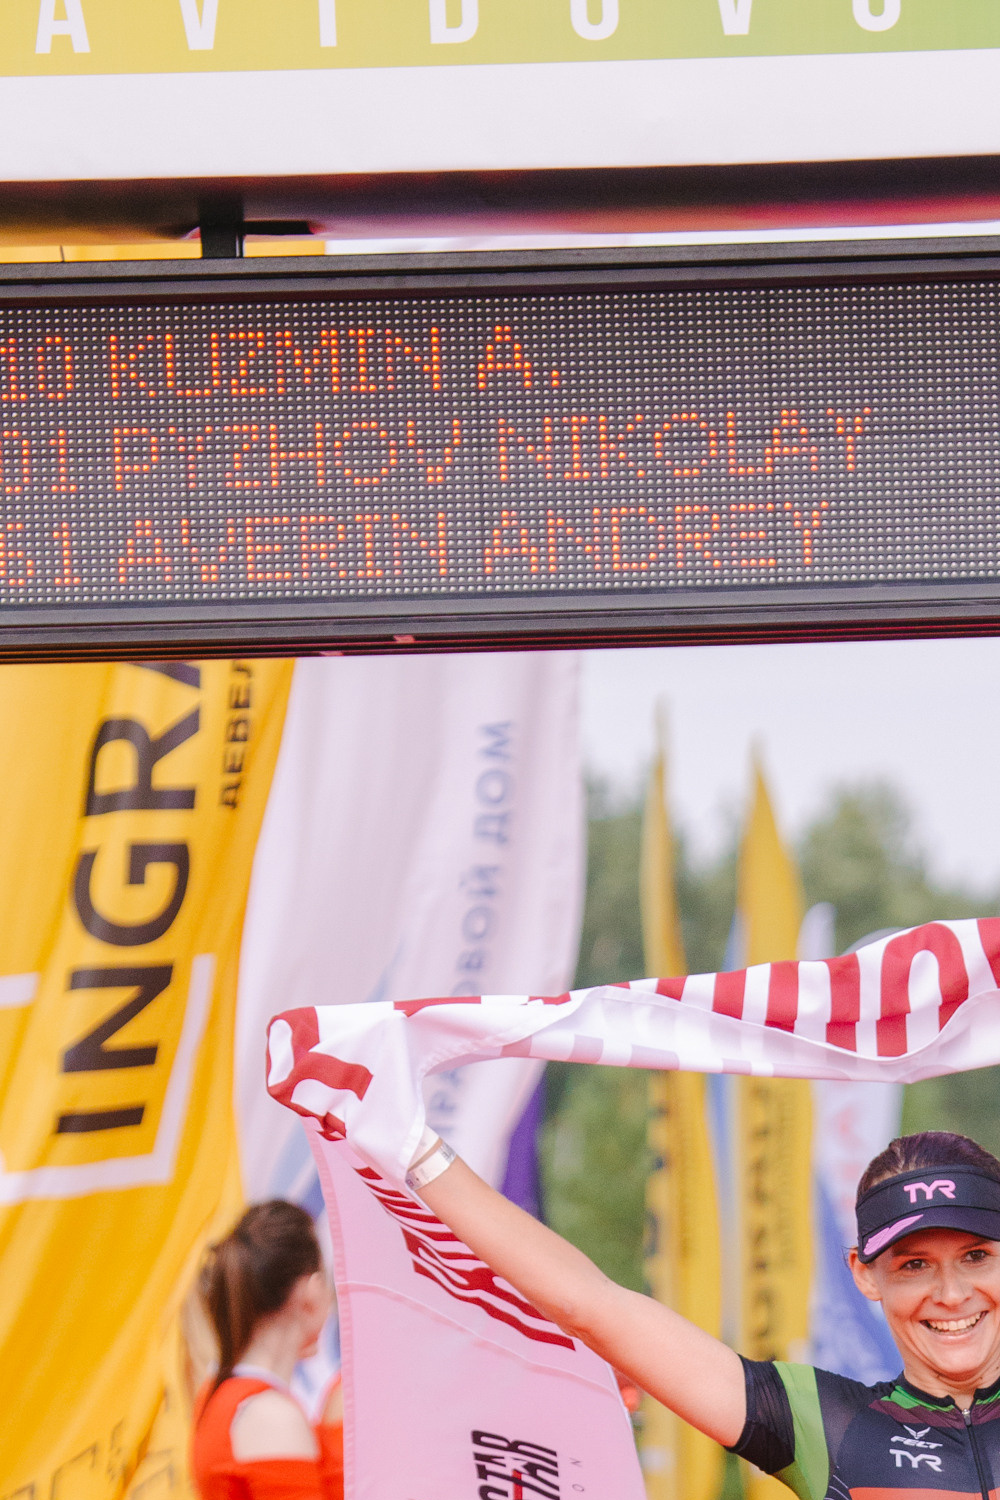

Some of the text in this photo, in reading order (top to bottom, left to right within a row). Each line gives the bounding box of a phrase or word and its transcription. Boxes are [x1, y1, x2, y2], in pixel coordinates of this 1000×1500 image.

[108, 326, 442, 399] KUZMIN
[476, 323, 562, 391] A.
[112, 417, 461, 493] PYZHOV
[497, 406, 873, 483] NIKOLAY
[117, 511, 448, 584] AVERIN
[483, 500, 830, 575] ANDREY
[903, 1179, 957, 1204] TYR
[889, 1448, 943, 1473] TYR
